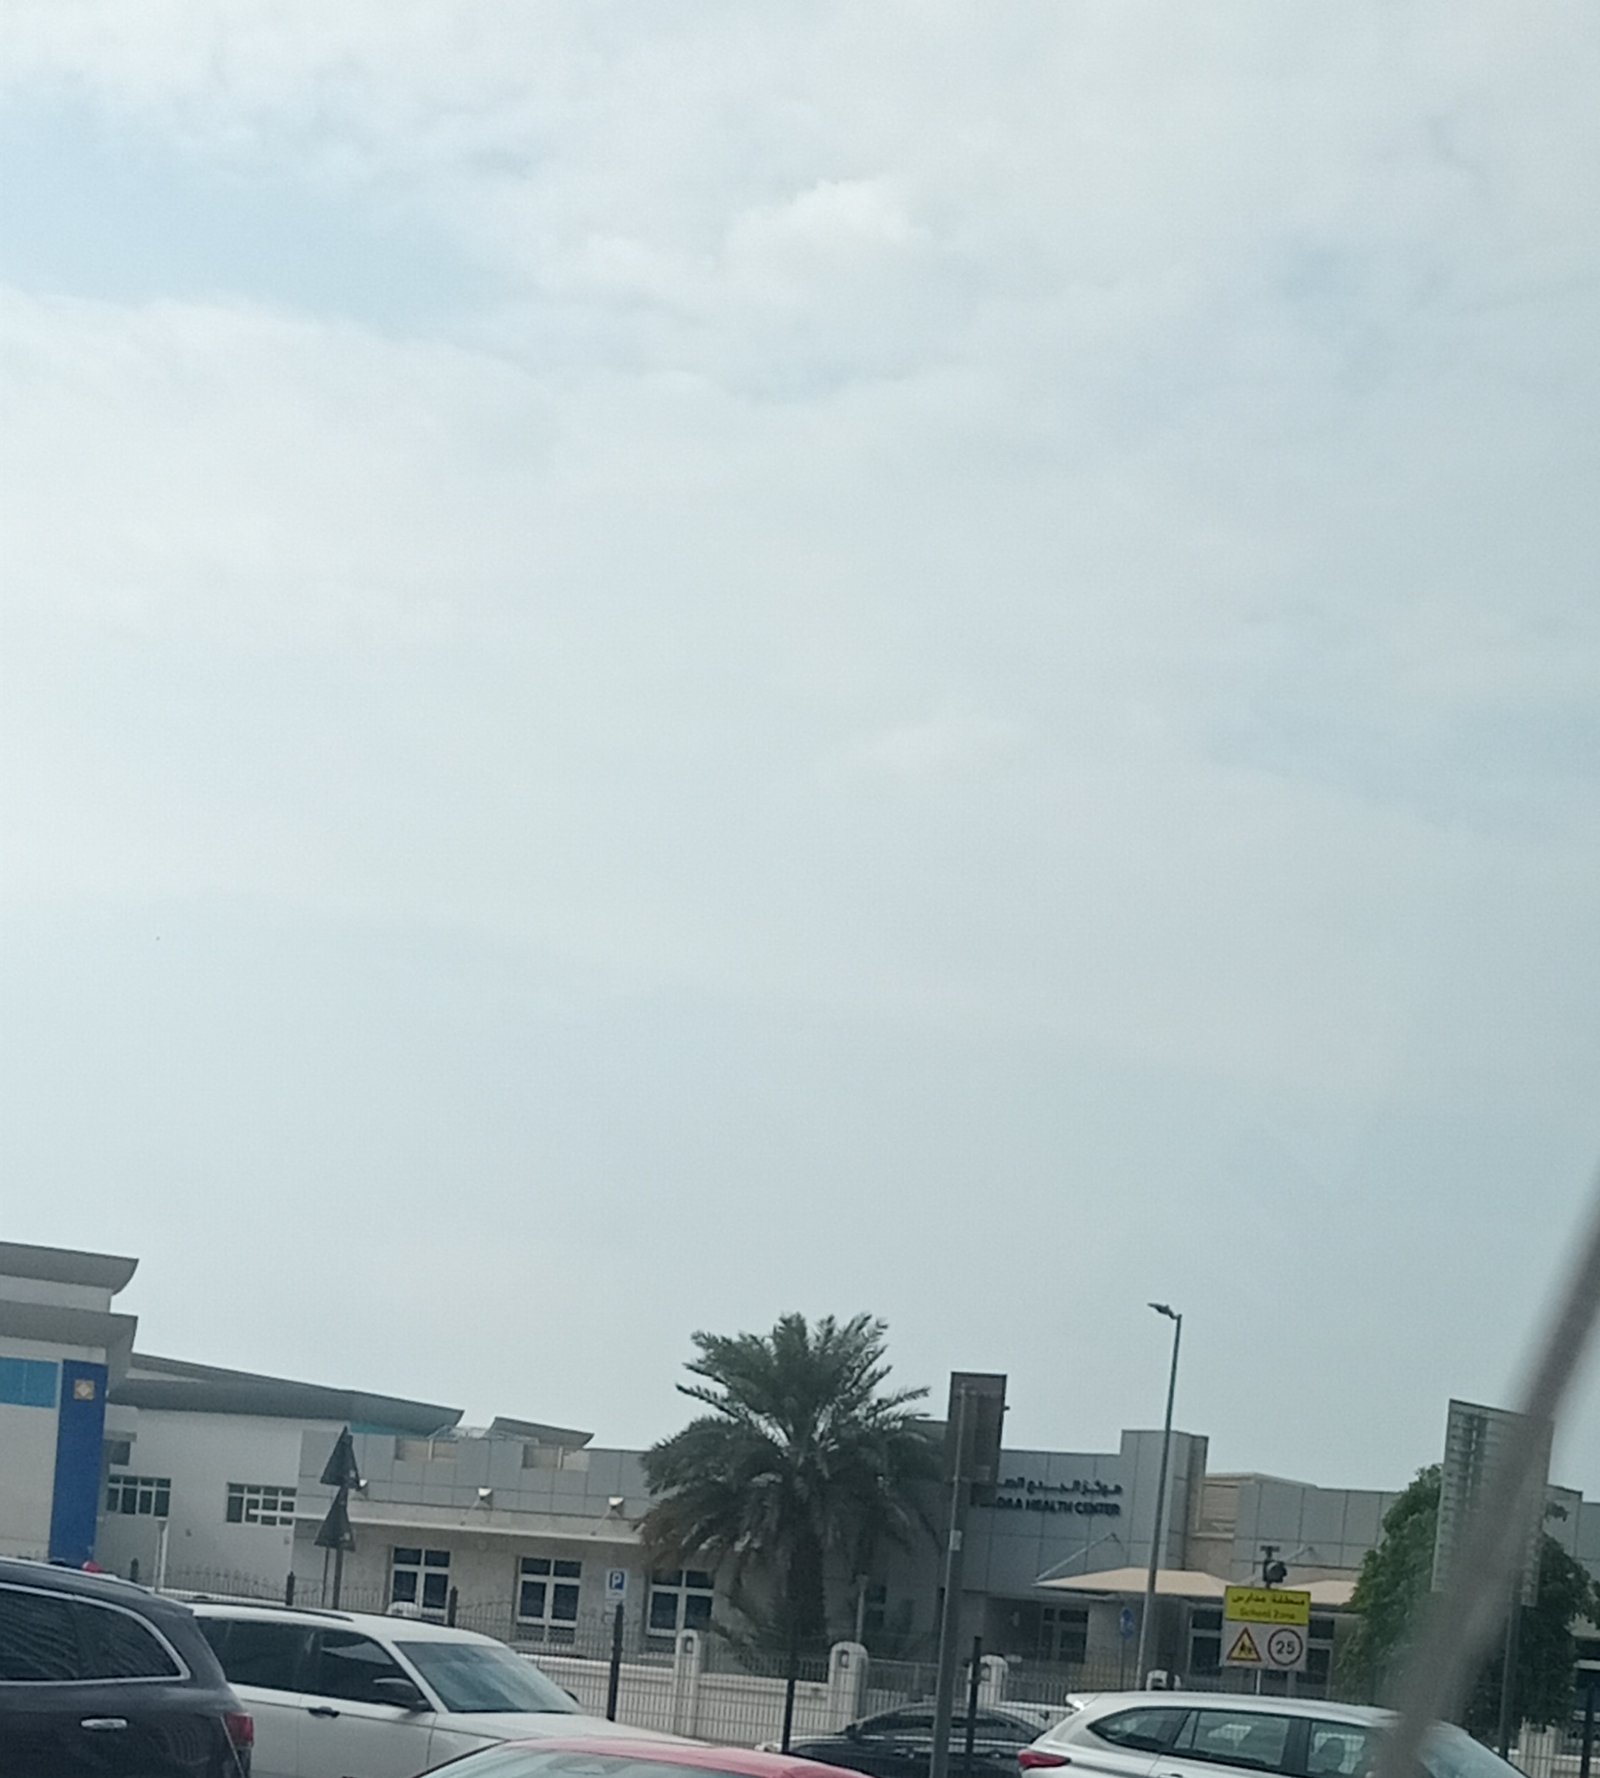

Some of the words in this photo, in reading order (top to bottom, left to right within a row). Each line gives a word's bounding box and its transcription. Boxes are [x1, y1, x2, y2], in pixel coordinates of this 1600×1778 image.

[1025, 1499, 1073, 1514] HEALTH
[1074, 1501, 1122, 1516] CENTER
[611, 1572, 622, 1589] P
[1275, 1640, 1296, 1655] 25
